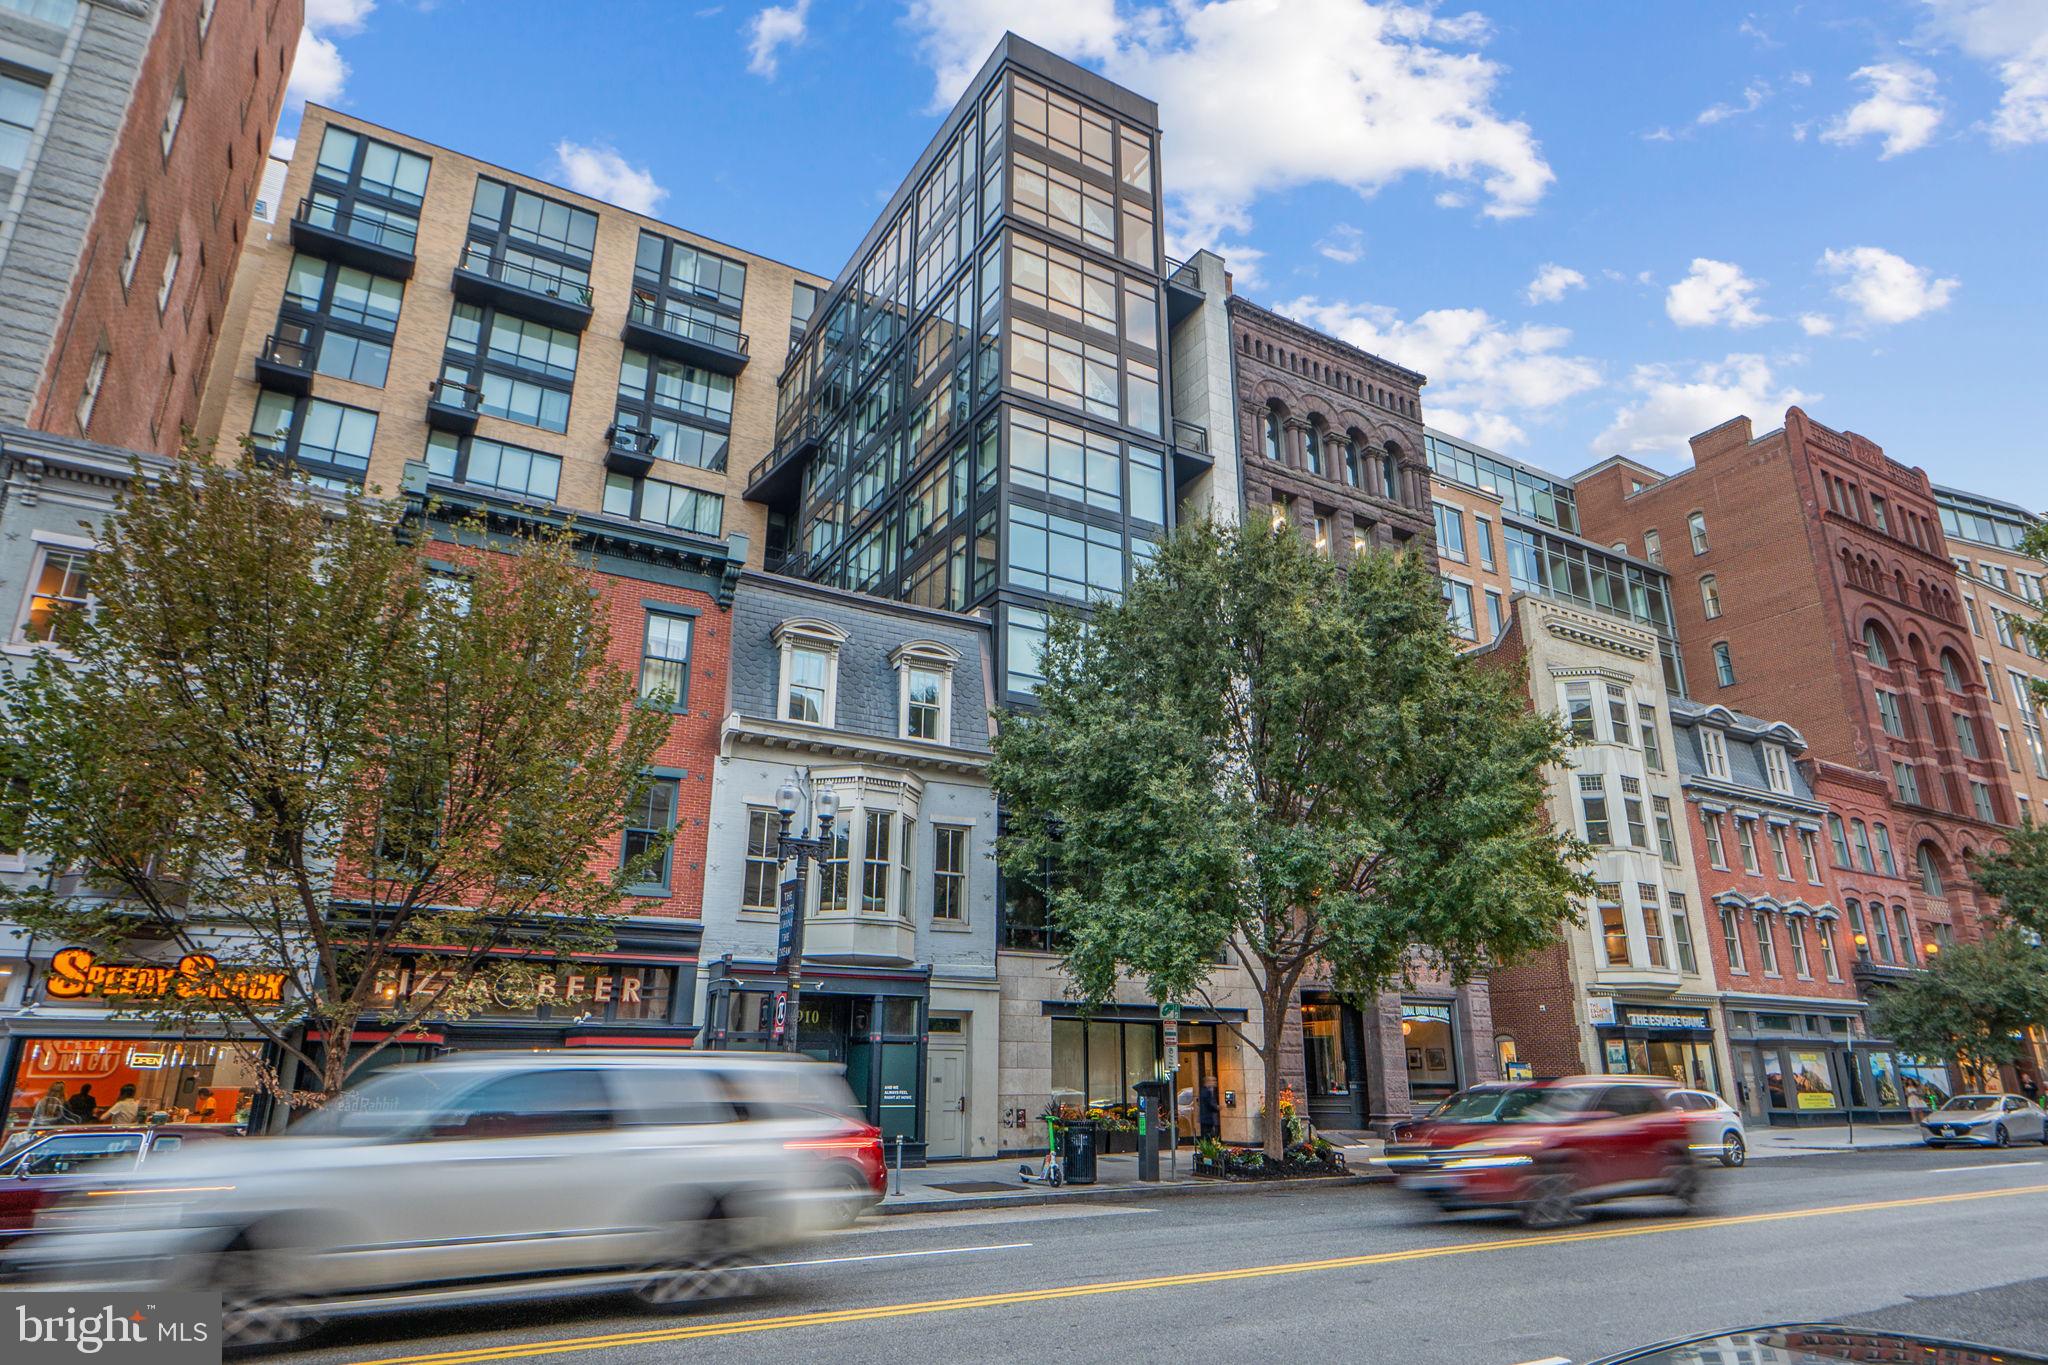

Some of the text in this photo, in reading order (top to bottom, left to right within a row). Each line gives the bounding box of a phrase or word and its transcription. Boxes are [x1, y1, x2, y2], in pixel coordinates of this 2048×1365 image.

[48, 948, 175, 997] SPEEDY
[536, 973, 641, 1002] BEER
[1628, 1013, 1706, 1029] THE ESCAPE GAME
[133, 1056, 161, 1066] OPEN
